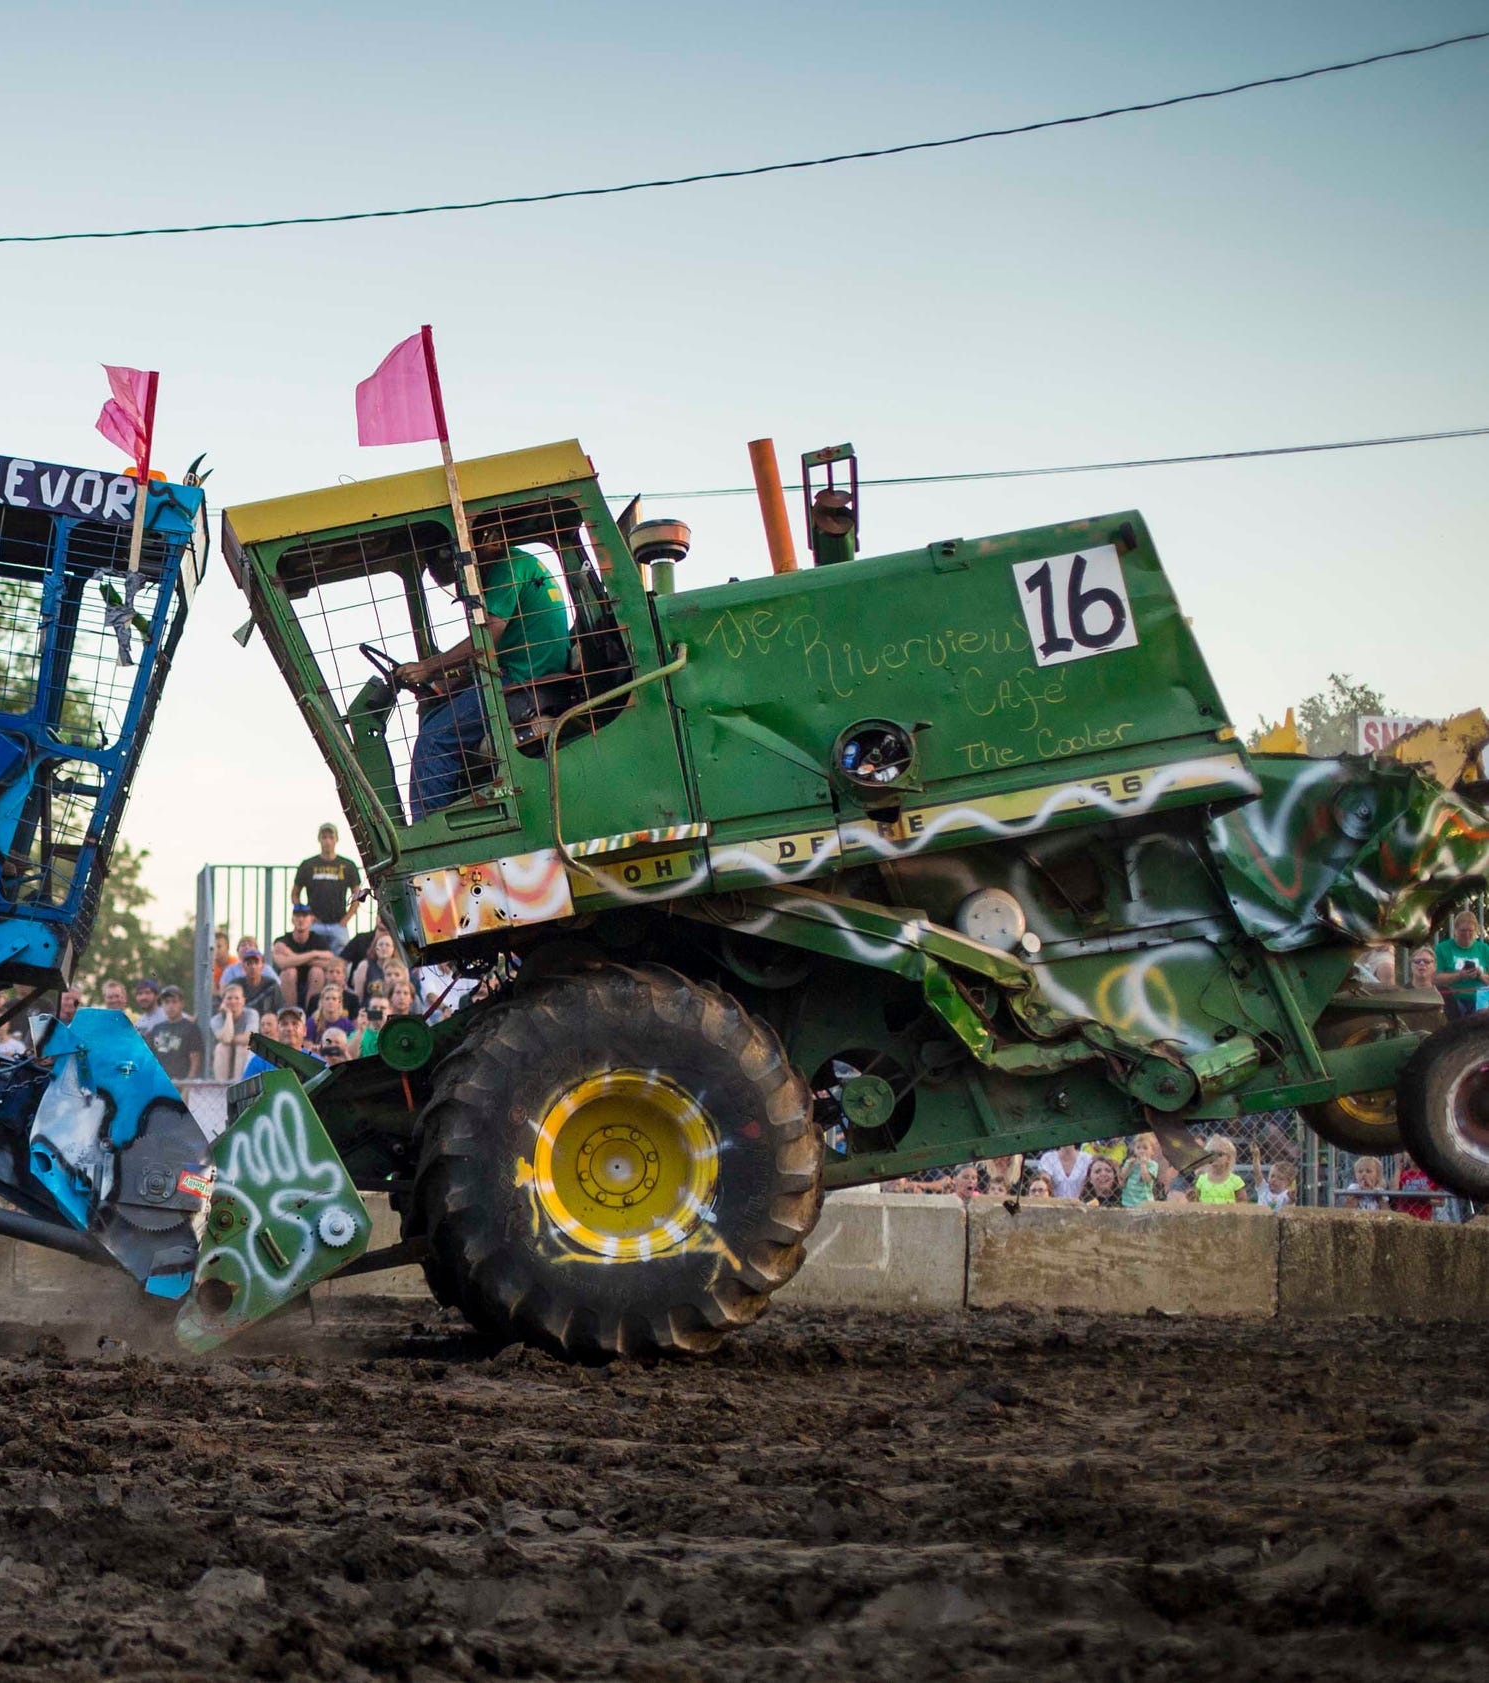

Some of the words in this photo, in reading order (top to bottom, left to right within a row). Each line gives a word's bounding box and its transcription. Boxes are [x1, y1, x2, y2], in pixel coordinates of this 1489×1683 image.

[1024, 554, 1127, 660] 16
[954, 740, 1025, 769] The
[1037, 722, 1135, 759] Cooler
[1364, 721, 1415, 755] SN
[777, 814, 926, 860] DERE
